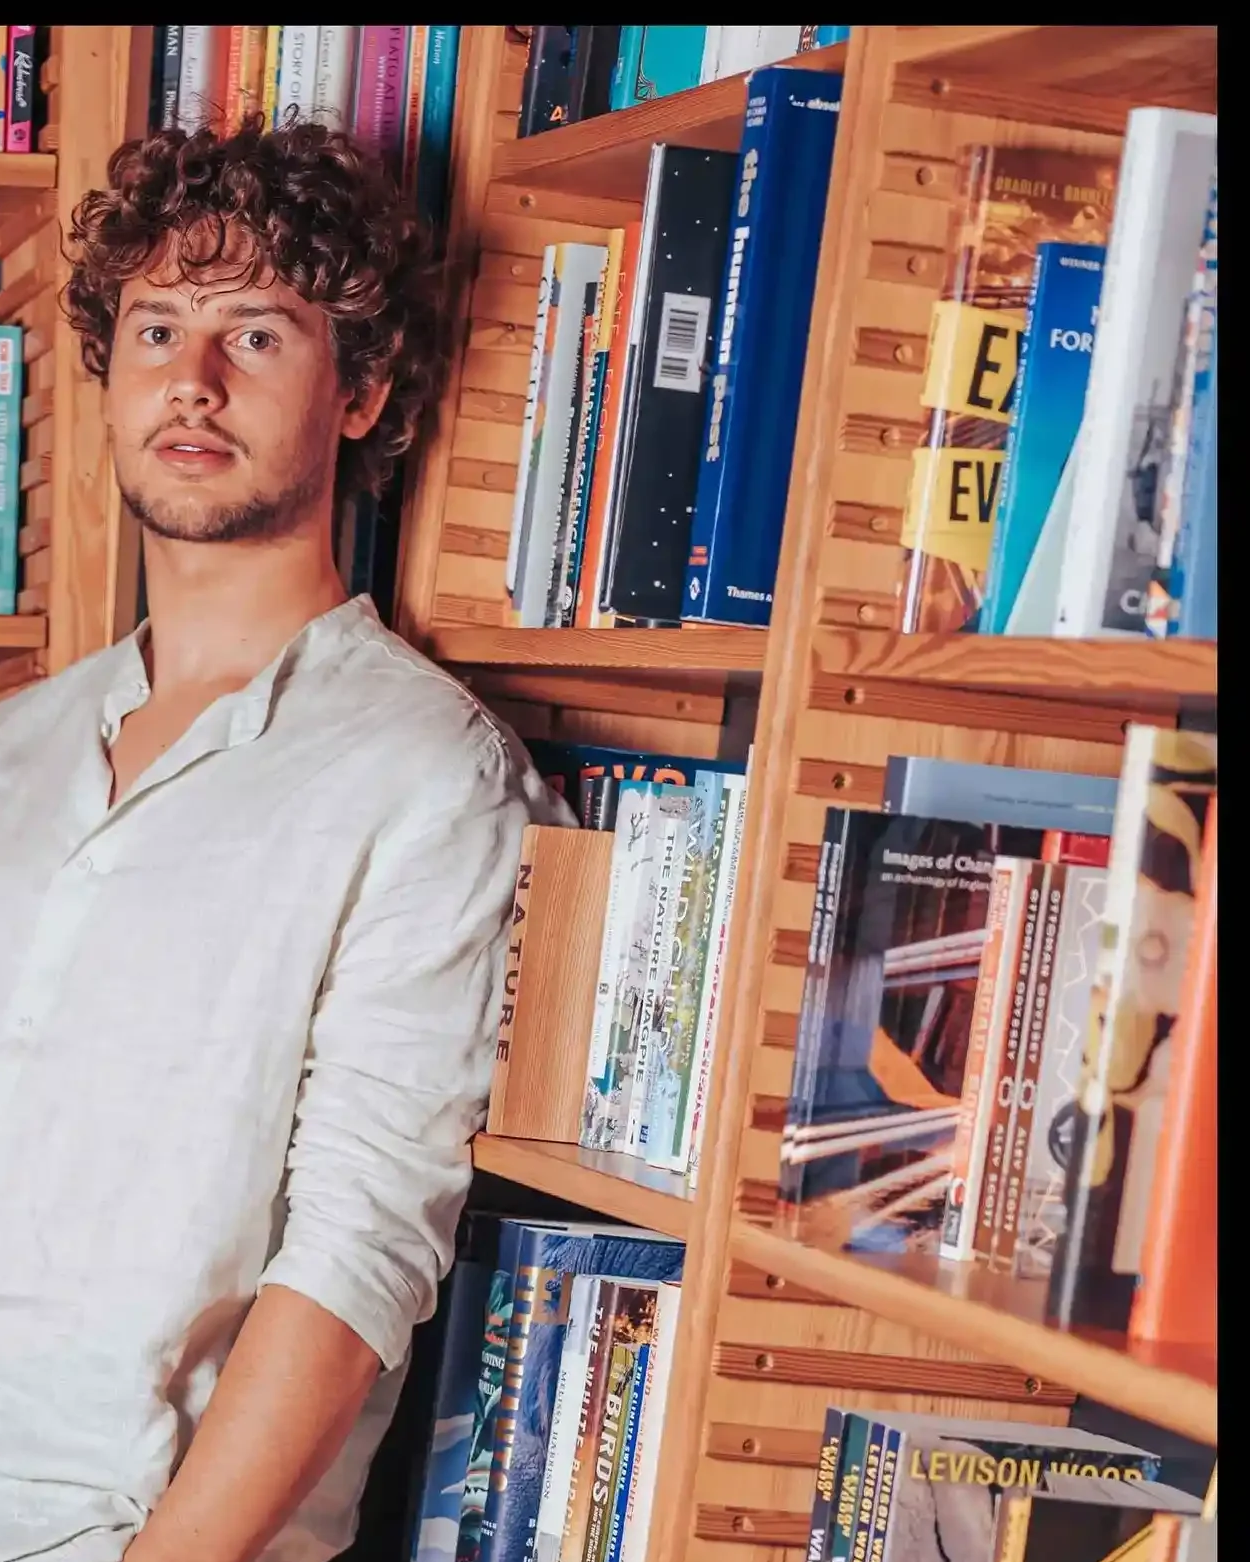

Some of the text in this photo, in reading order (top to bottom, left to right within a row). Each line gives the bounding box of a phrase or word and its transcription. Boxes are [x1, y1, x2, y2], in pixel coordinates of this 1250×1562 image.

[290, 32, 304, 76] STORY
[717, 226, 750, 366] human
[596, 368, 614, 452] FOOD
[566, 460, 587, 553] SCIENCE
[698, 799, 728, 942] FIELD WORK
[882, 848, 954, 871] Images of
[495, 864, 532, 1063] NATURE
[634, 833, 676, 1083] THE NATURE MAGPIE
[657, 818, 701, 1057] WILD CHILD
[980, 888, 1040, 1228] OTTOMAN ODYSSEY ALEV SCOTT
[1003, 889, 1061, 1232] OTTOMAN ODYSSEY ALEV SCOTT
[542, 1369, 568, 1500] MELISSA HARRISON
[573, 1306, 605, 1449] THE WHITE
[590, 1392, 623, 1508] BIRDS
[859, 1443, 882, 1525] LEVISON
[875, 1450, 897, 1532] LEVISON
[910, 1448, 1041, 1489] LEVISON
